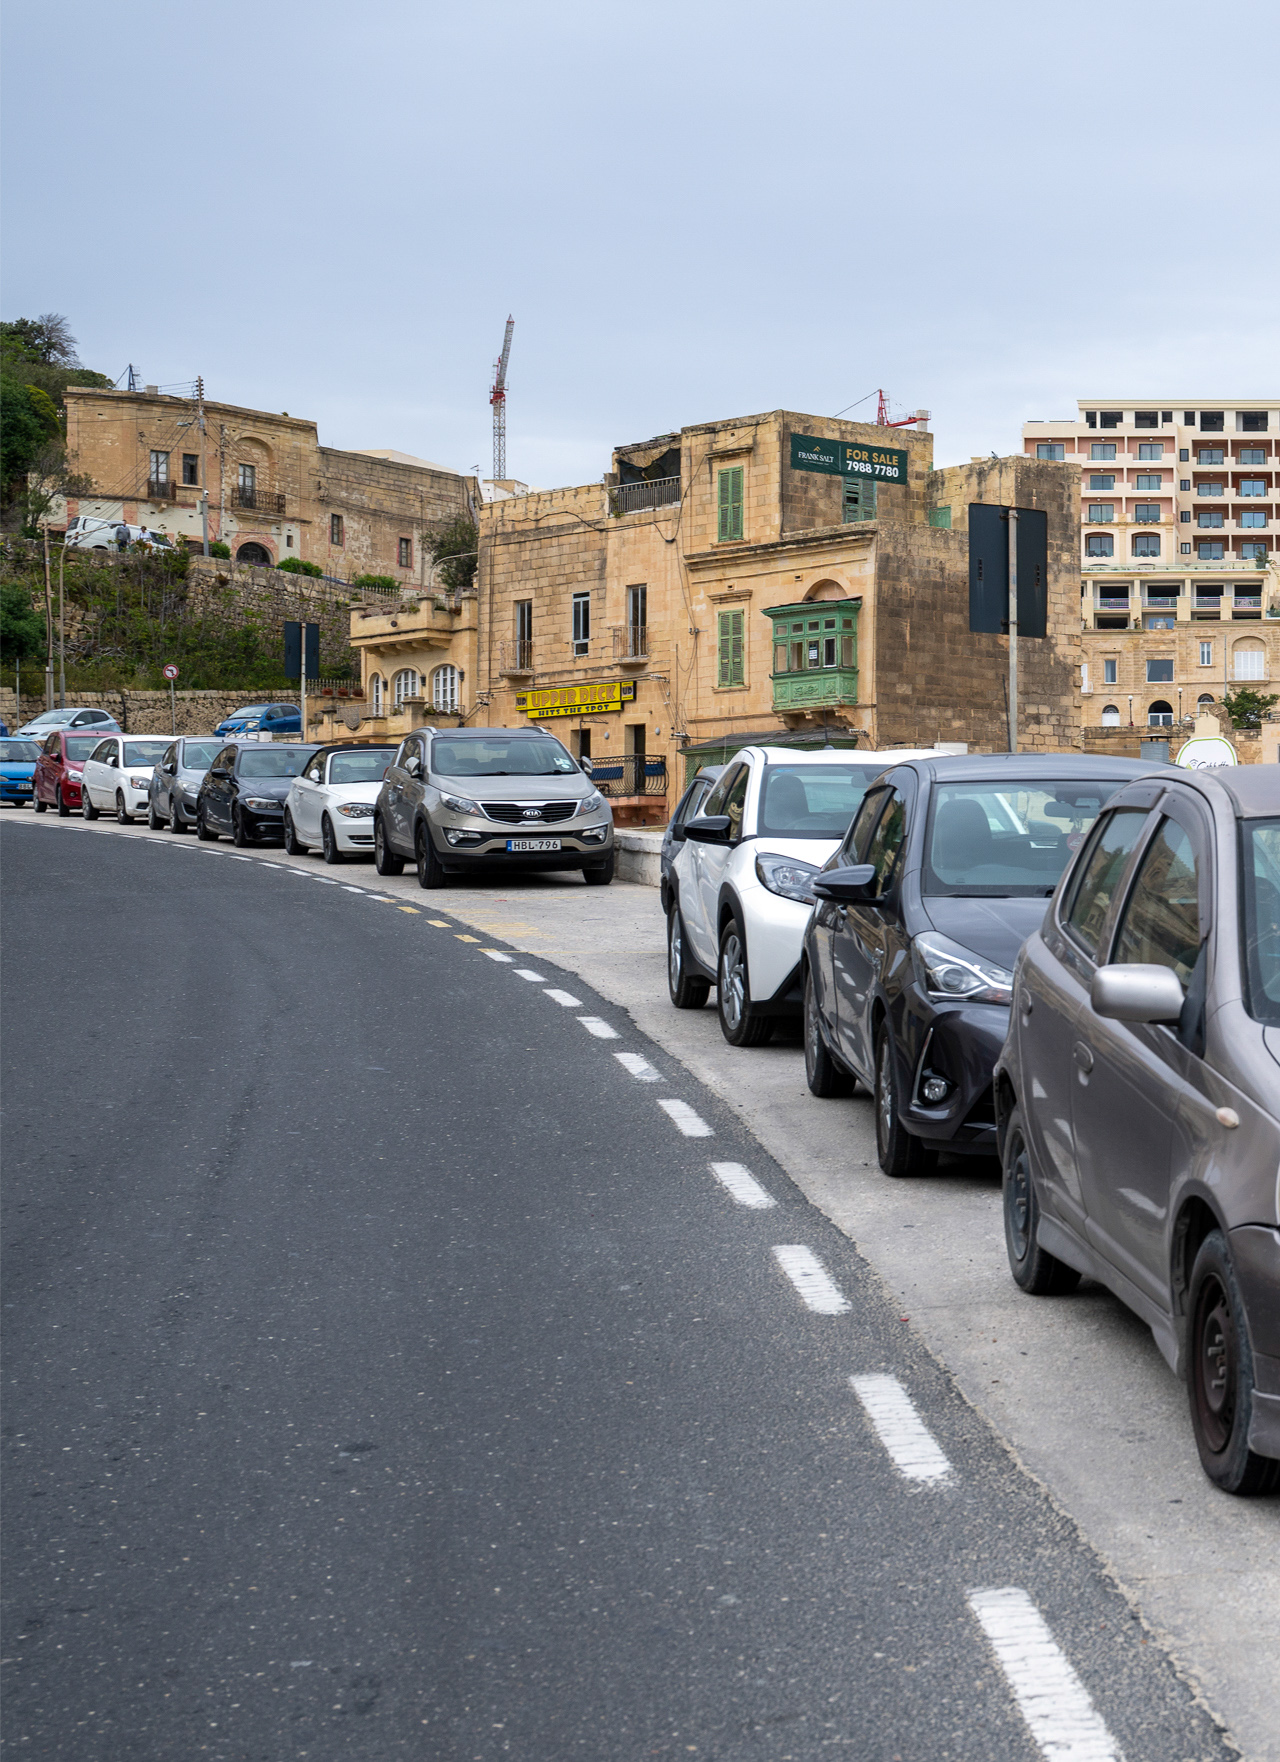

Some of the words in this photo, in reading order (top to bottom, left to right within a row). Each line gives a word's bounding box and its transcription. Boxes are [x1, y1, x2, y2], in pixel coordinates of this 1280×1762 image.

[798, 451, 819, 461] FRANK
[819, 454, 835, 463] SALT
[846, 449, 869, 461] FOR
[872, 452, 899, 466] SALE
[846, 460, 873, 474] 7988
[873, 464, 899, 478] 7780
[531, 689, 576, 707] UPPER
[579, 685, 616, 703] DECK
[622, 686, 633, 695] UD
[538, 708, 561, 717] HITS
[563, 706, 582, 714] THE
[585, 704, 610, 713] SPOT
